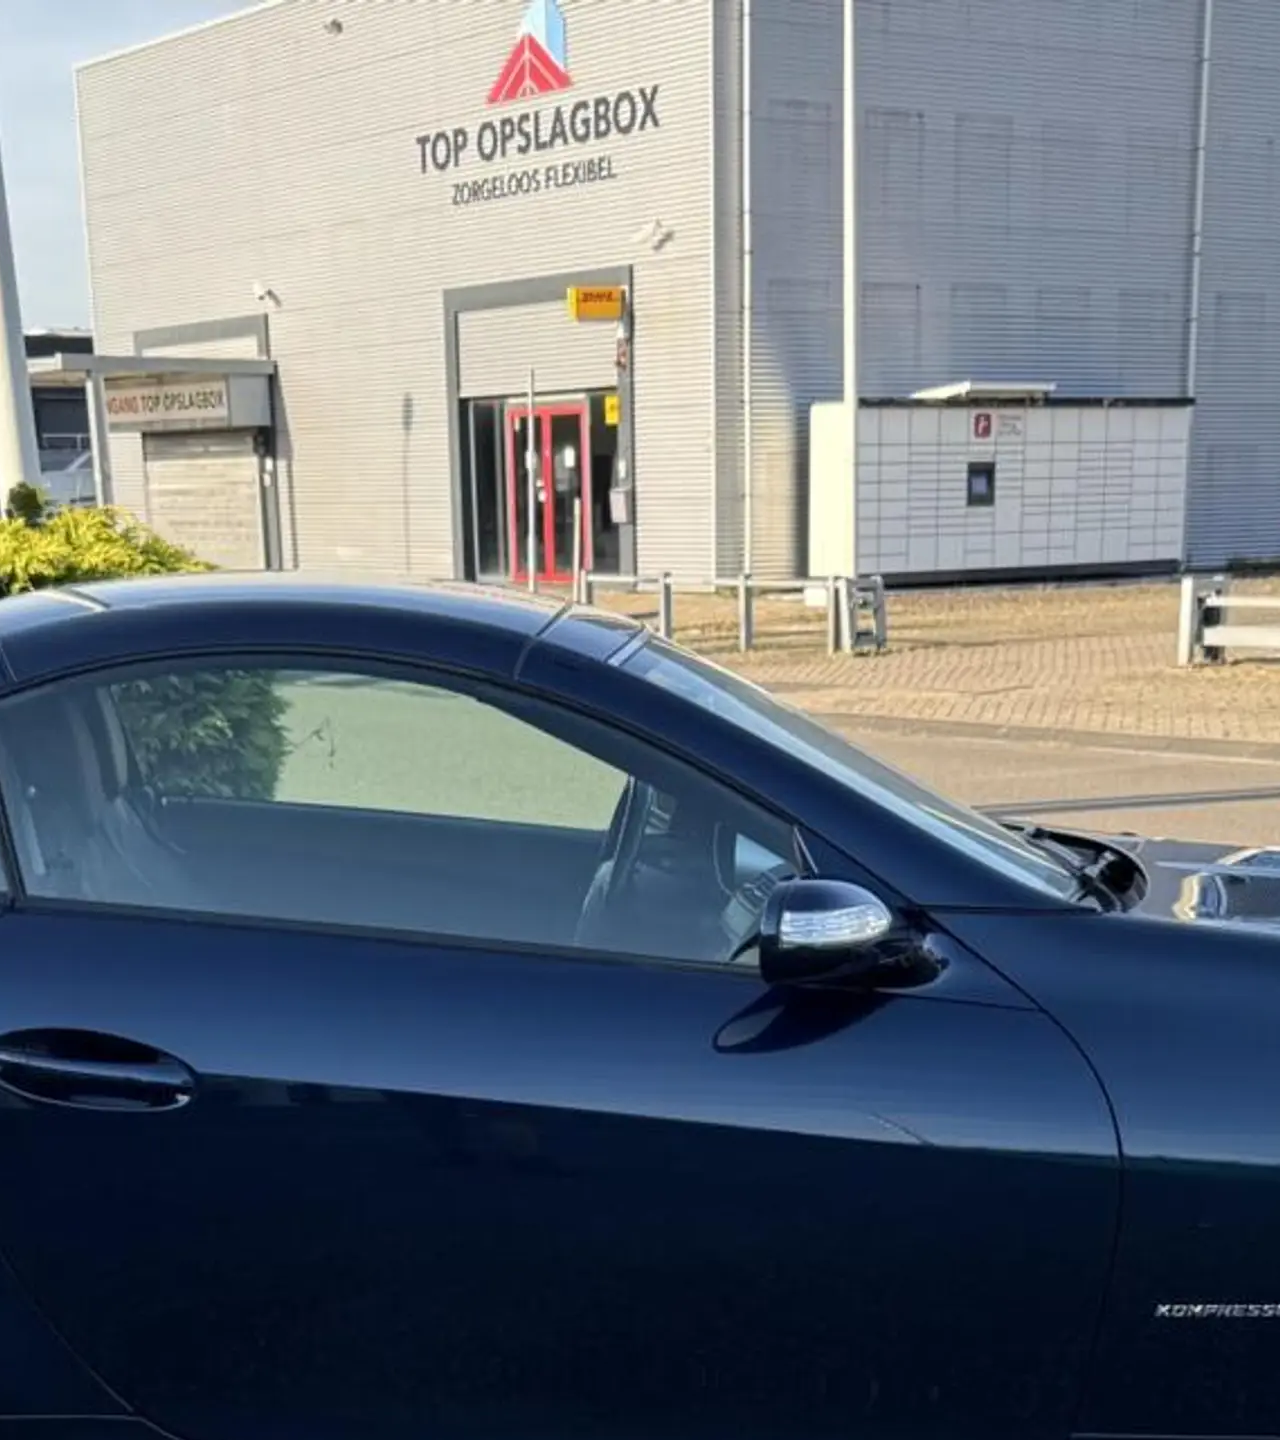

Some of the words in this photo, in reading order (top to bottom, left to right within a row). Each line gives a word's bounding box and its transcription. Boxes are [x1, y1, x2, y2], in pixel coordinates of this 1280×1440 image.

[416, 127, 468, 174] TOP
[477, 84, 660, 162] OPSLAGBOX
[452, 168, 541, 206] ZORGELOOS
[544, 156, 618, 190] FLEXIBEL
